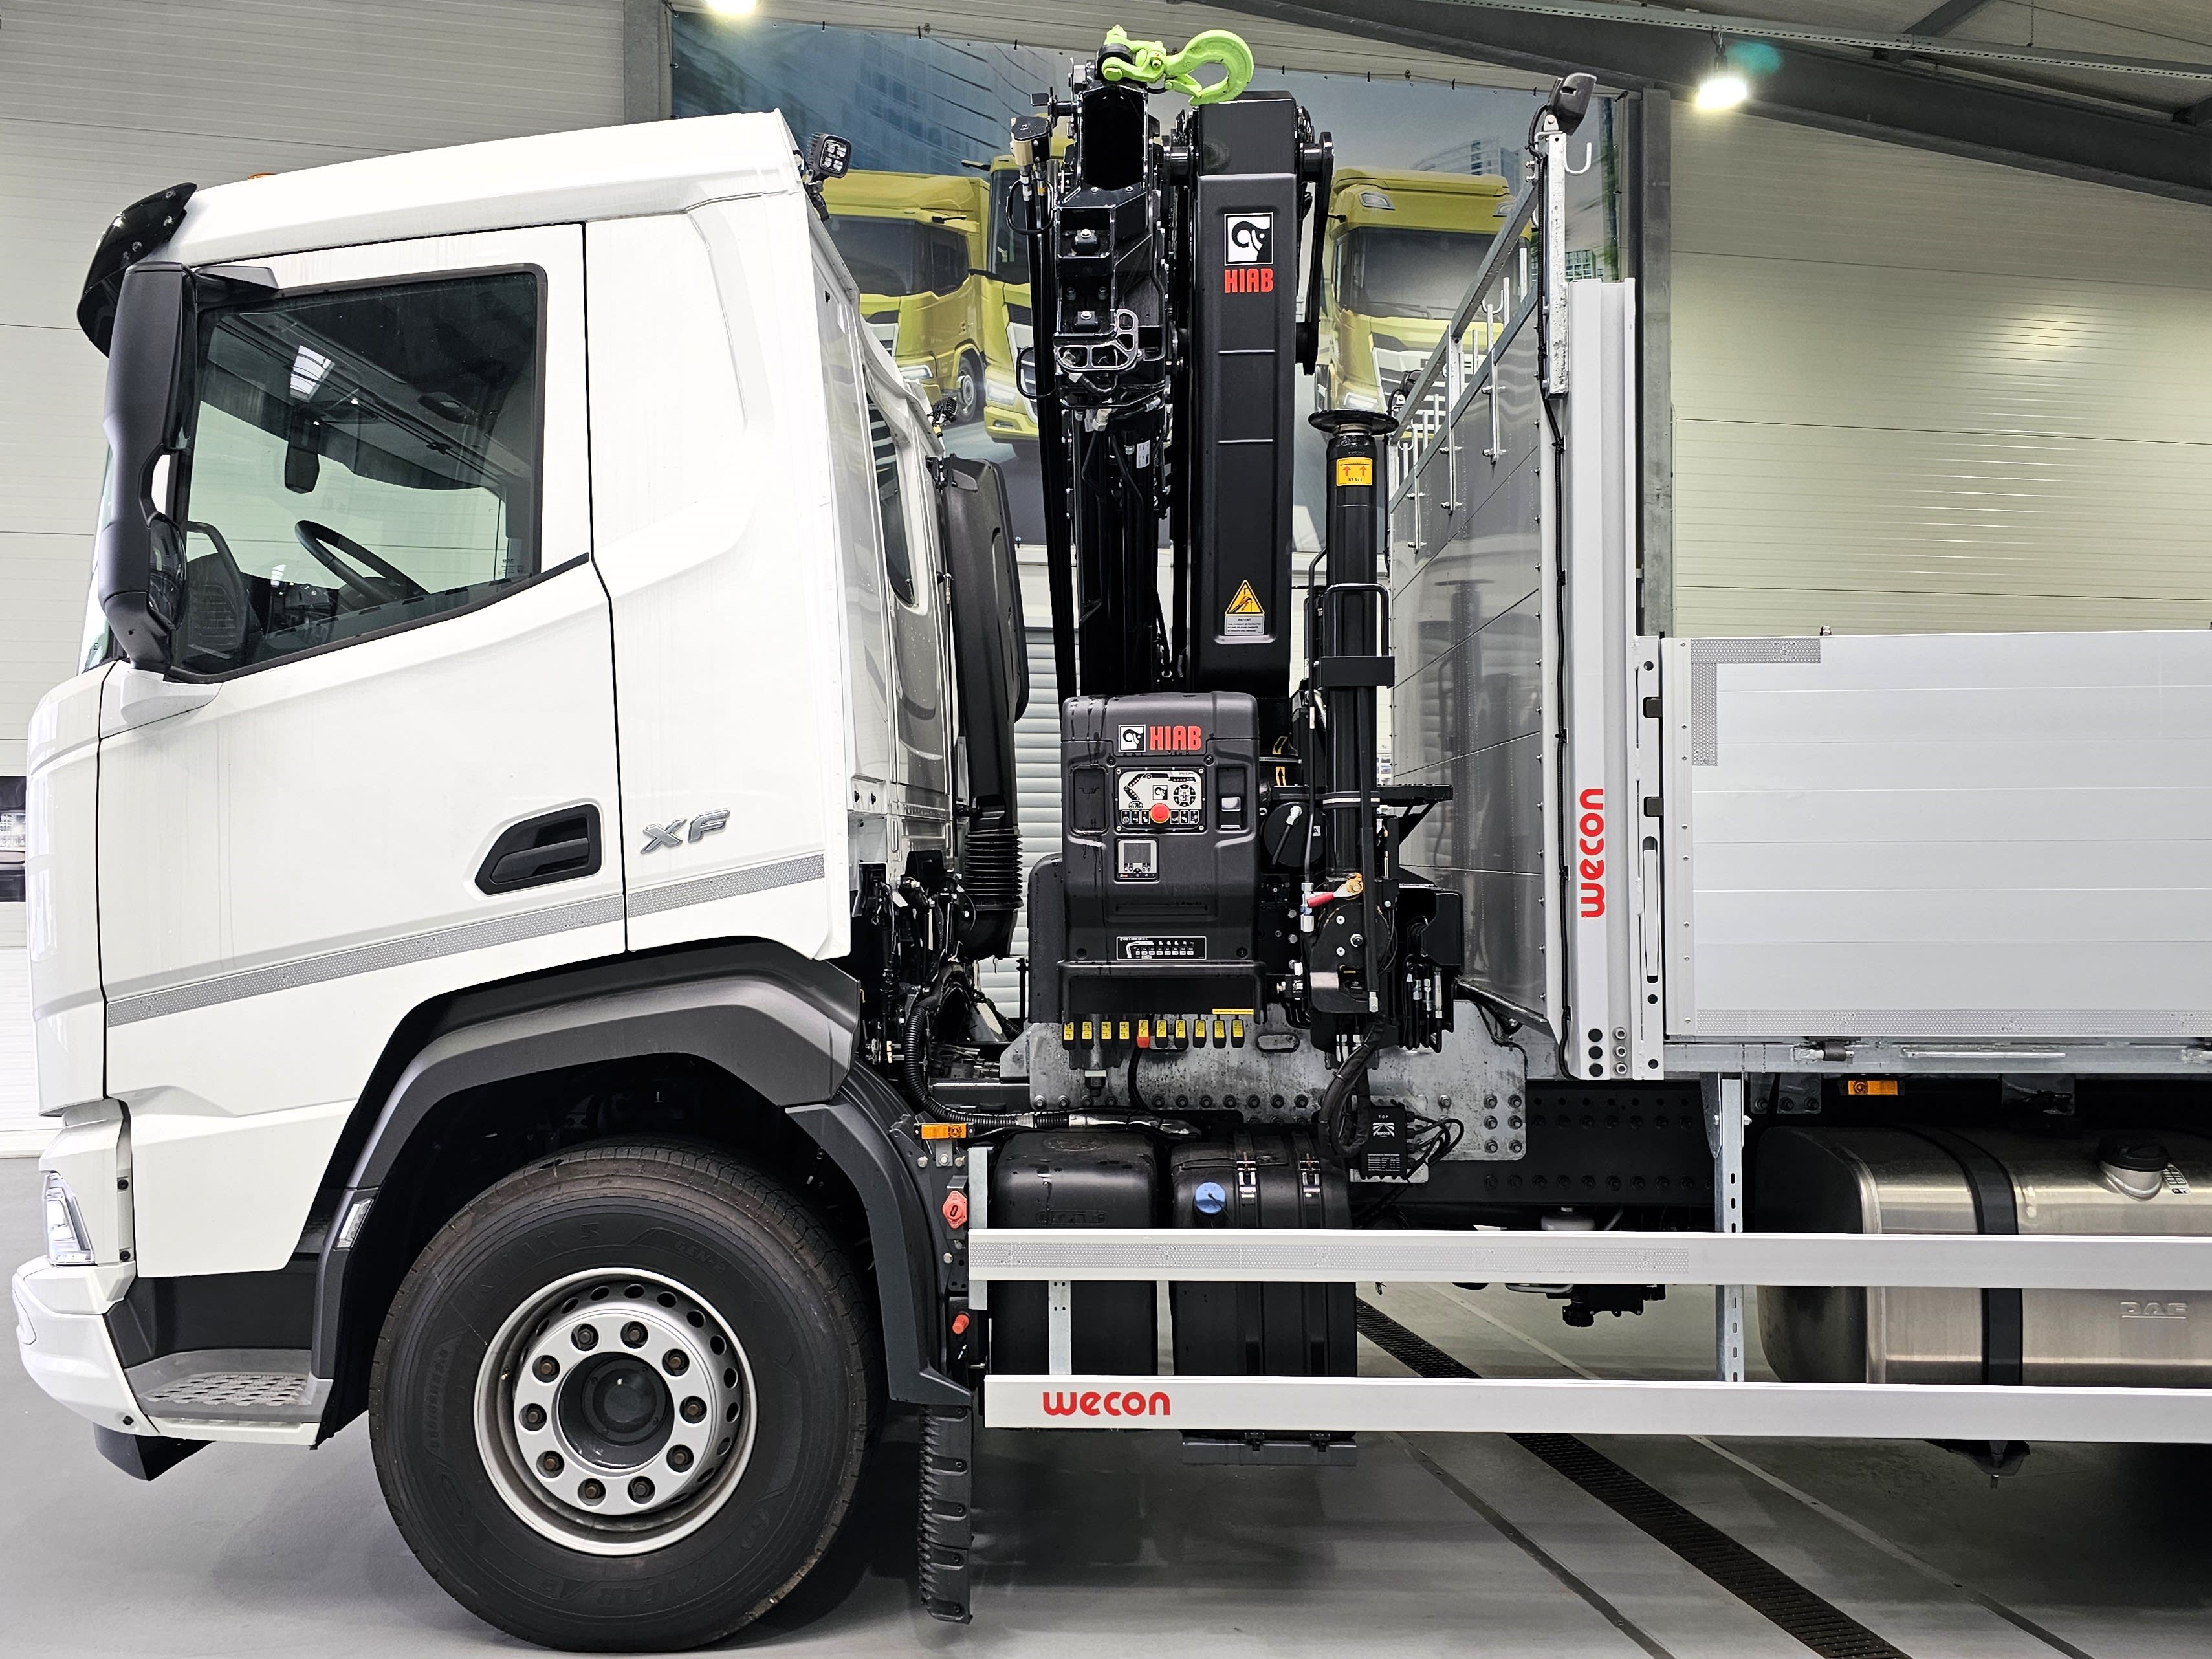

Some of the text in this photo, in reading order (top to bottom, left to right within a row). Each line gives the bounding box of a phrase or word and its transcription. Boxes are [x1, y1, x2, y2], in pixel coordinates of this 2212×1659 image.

[1225, 268, 1274, 294] HIAB
[1150, 725, 1201, 751] HIAB
[640, 807, 731, 855] XF
[1579, 788, 1606, 918] wecon
[674, 1239, 728, 1273] GEN-2
[2119, 1301, 2188, 1315] DAF
[1042, 1391, 1171, 1416] wecon
